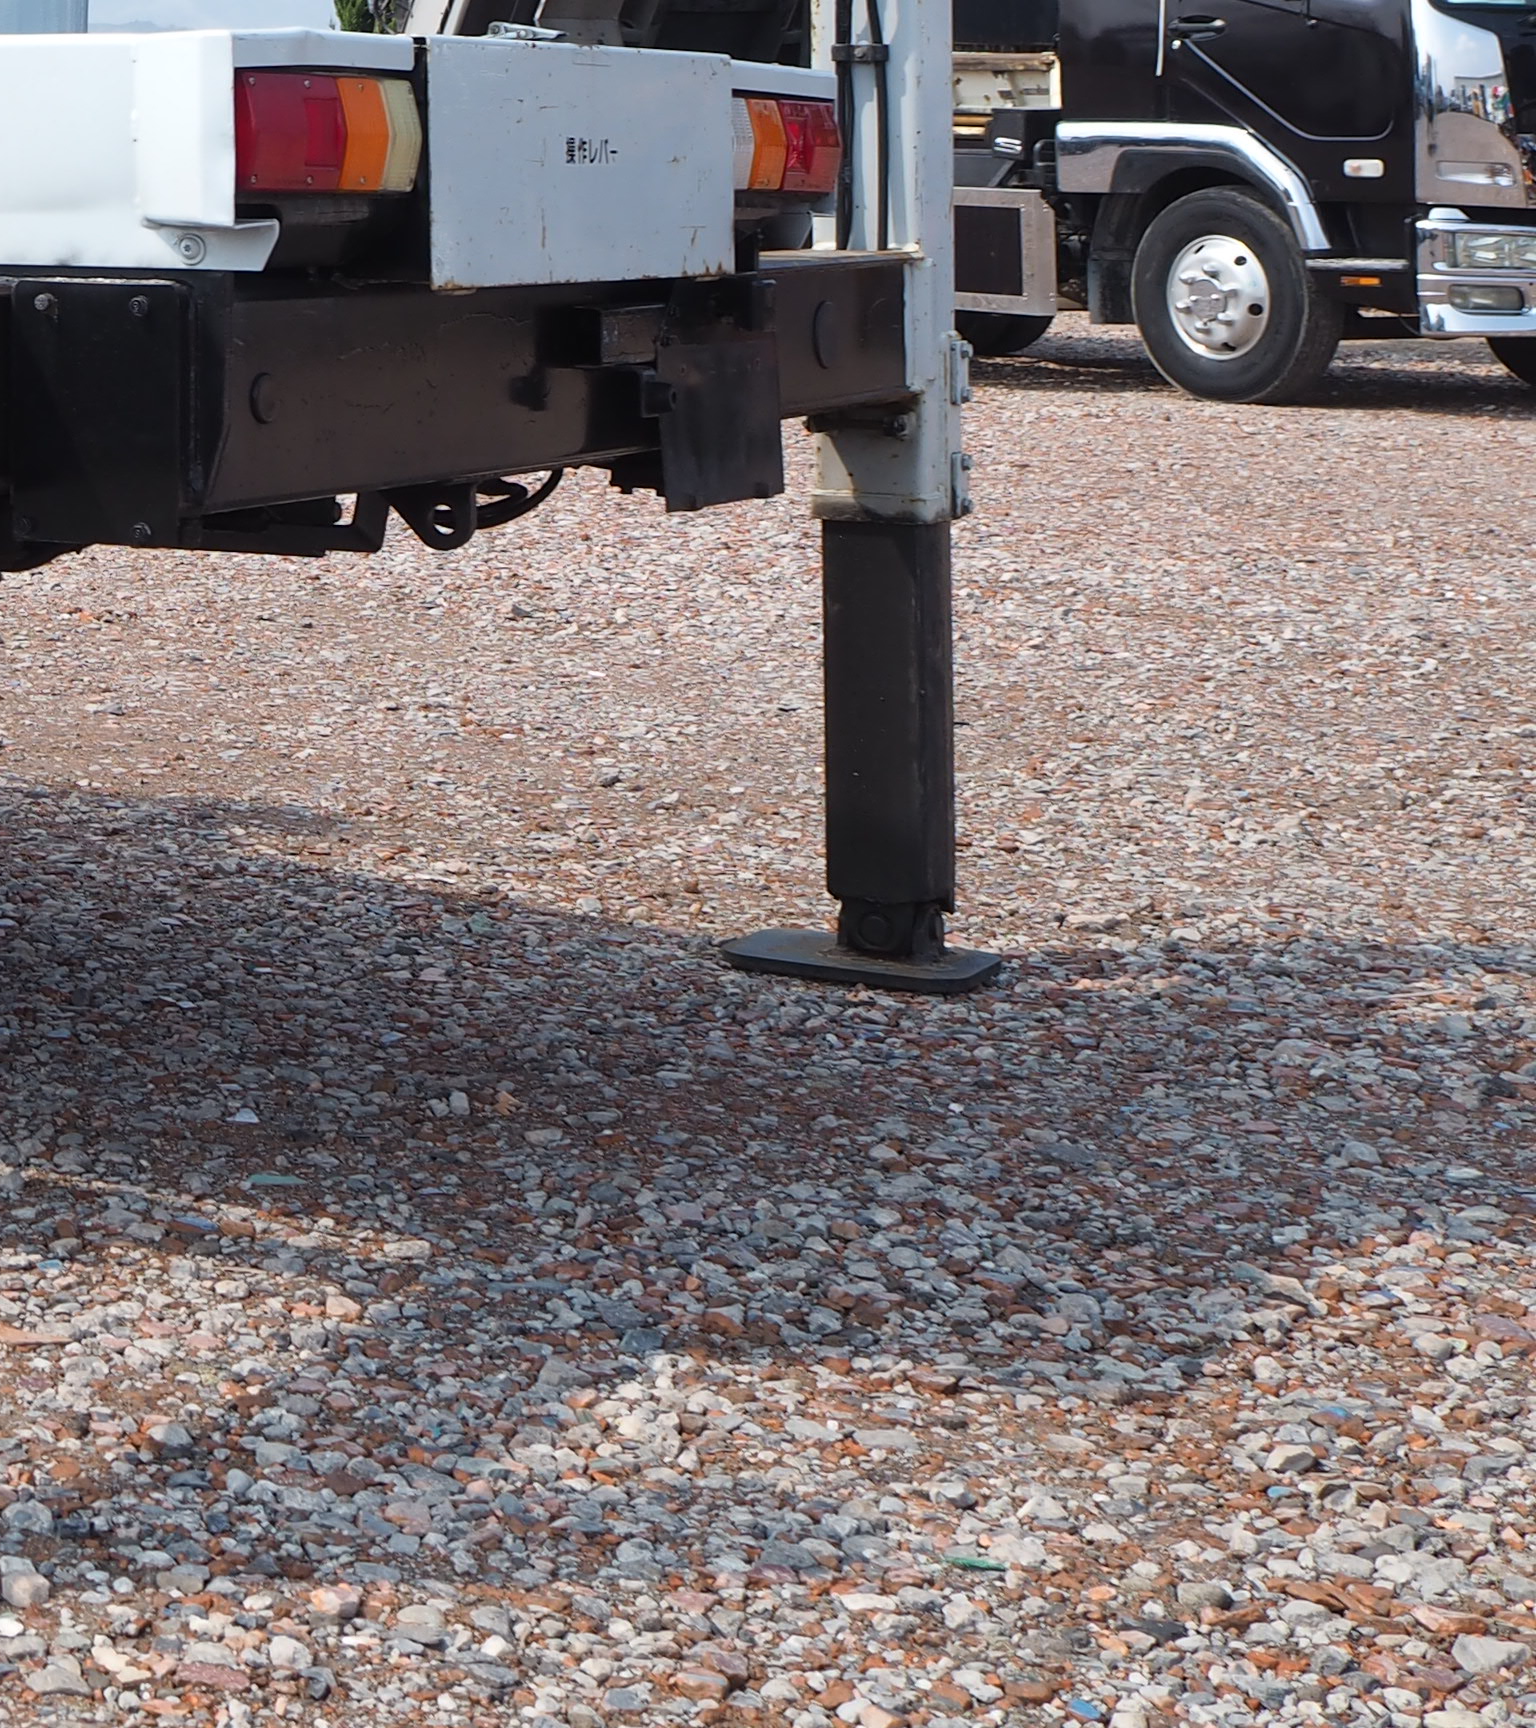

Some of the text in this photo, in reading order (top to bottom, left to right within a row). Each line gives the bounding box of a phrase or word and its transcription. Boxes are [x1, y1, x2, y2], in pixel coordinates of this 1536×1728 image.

[566, 137, 619, 164] 操作レバー
